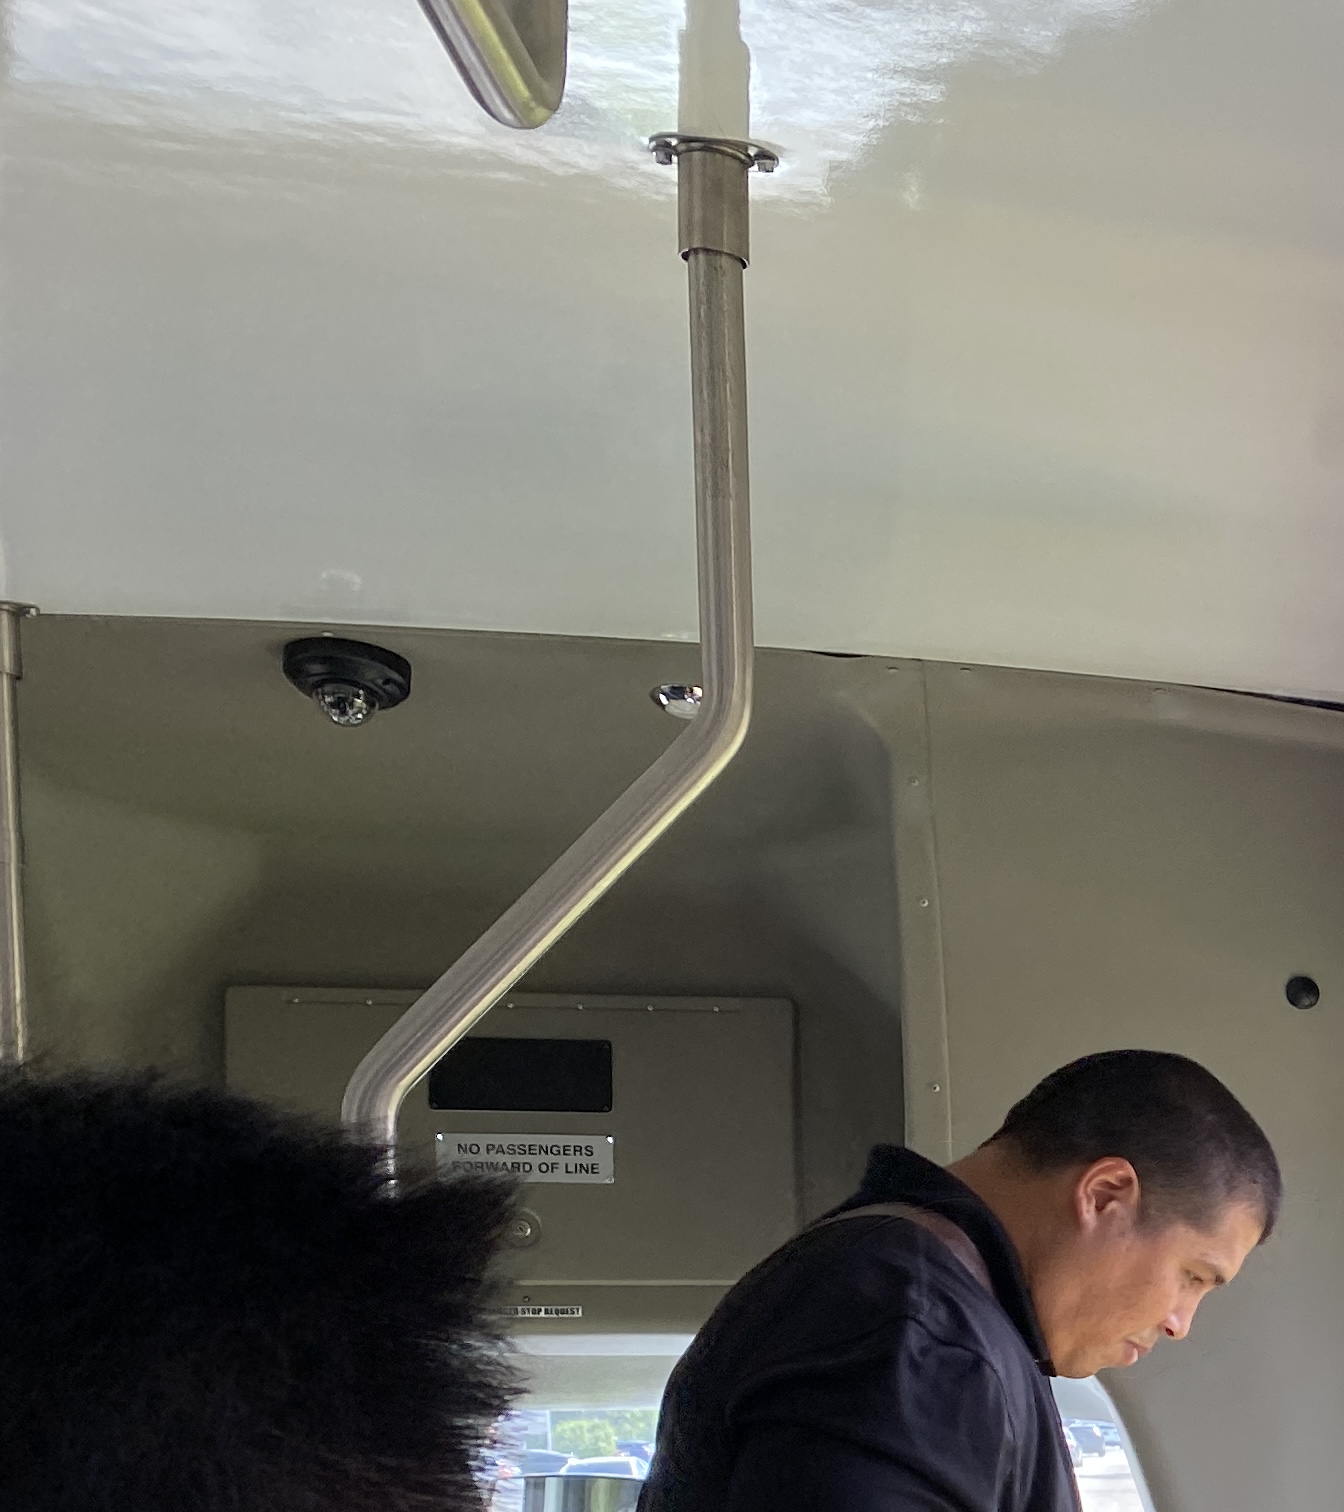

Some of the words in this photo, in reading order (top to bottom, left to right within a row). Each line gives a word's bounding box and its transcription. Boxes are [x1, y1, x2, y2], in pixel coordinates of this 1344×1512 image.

[457, 1143, 481, 1155] NO
[486, 1143, 594, 1157] PASSENGERS
[451, 1160, 533, 1174] FORWARD
[538, 1161, 560, 1174] OF
[564, 1162, 600, 1175] LINE
[520, 1308, 542, 1316] STOP
[543, 1308, 580, 1316] REQUEST
